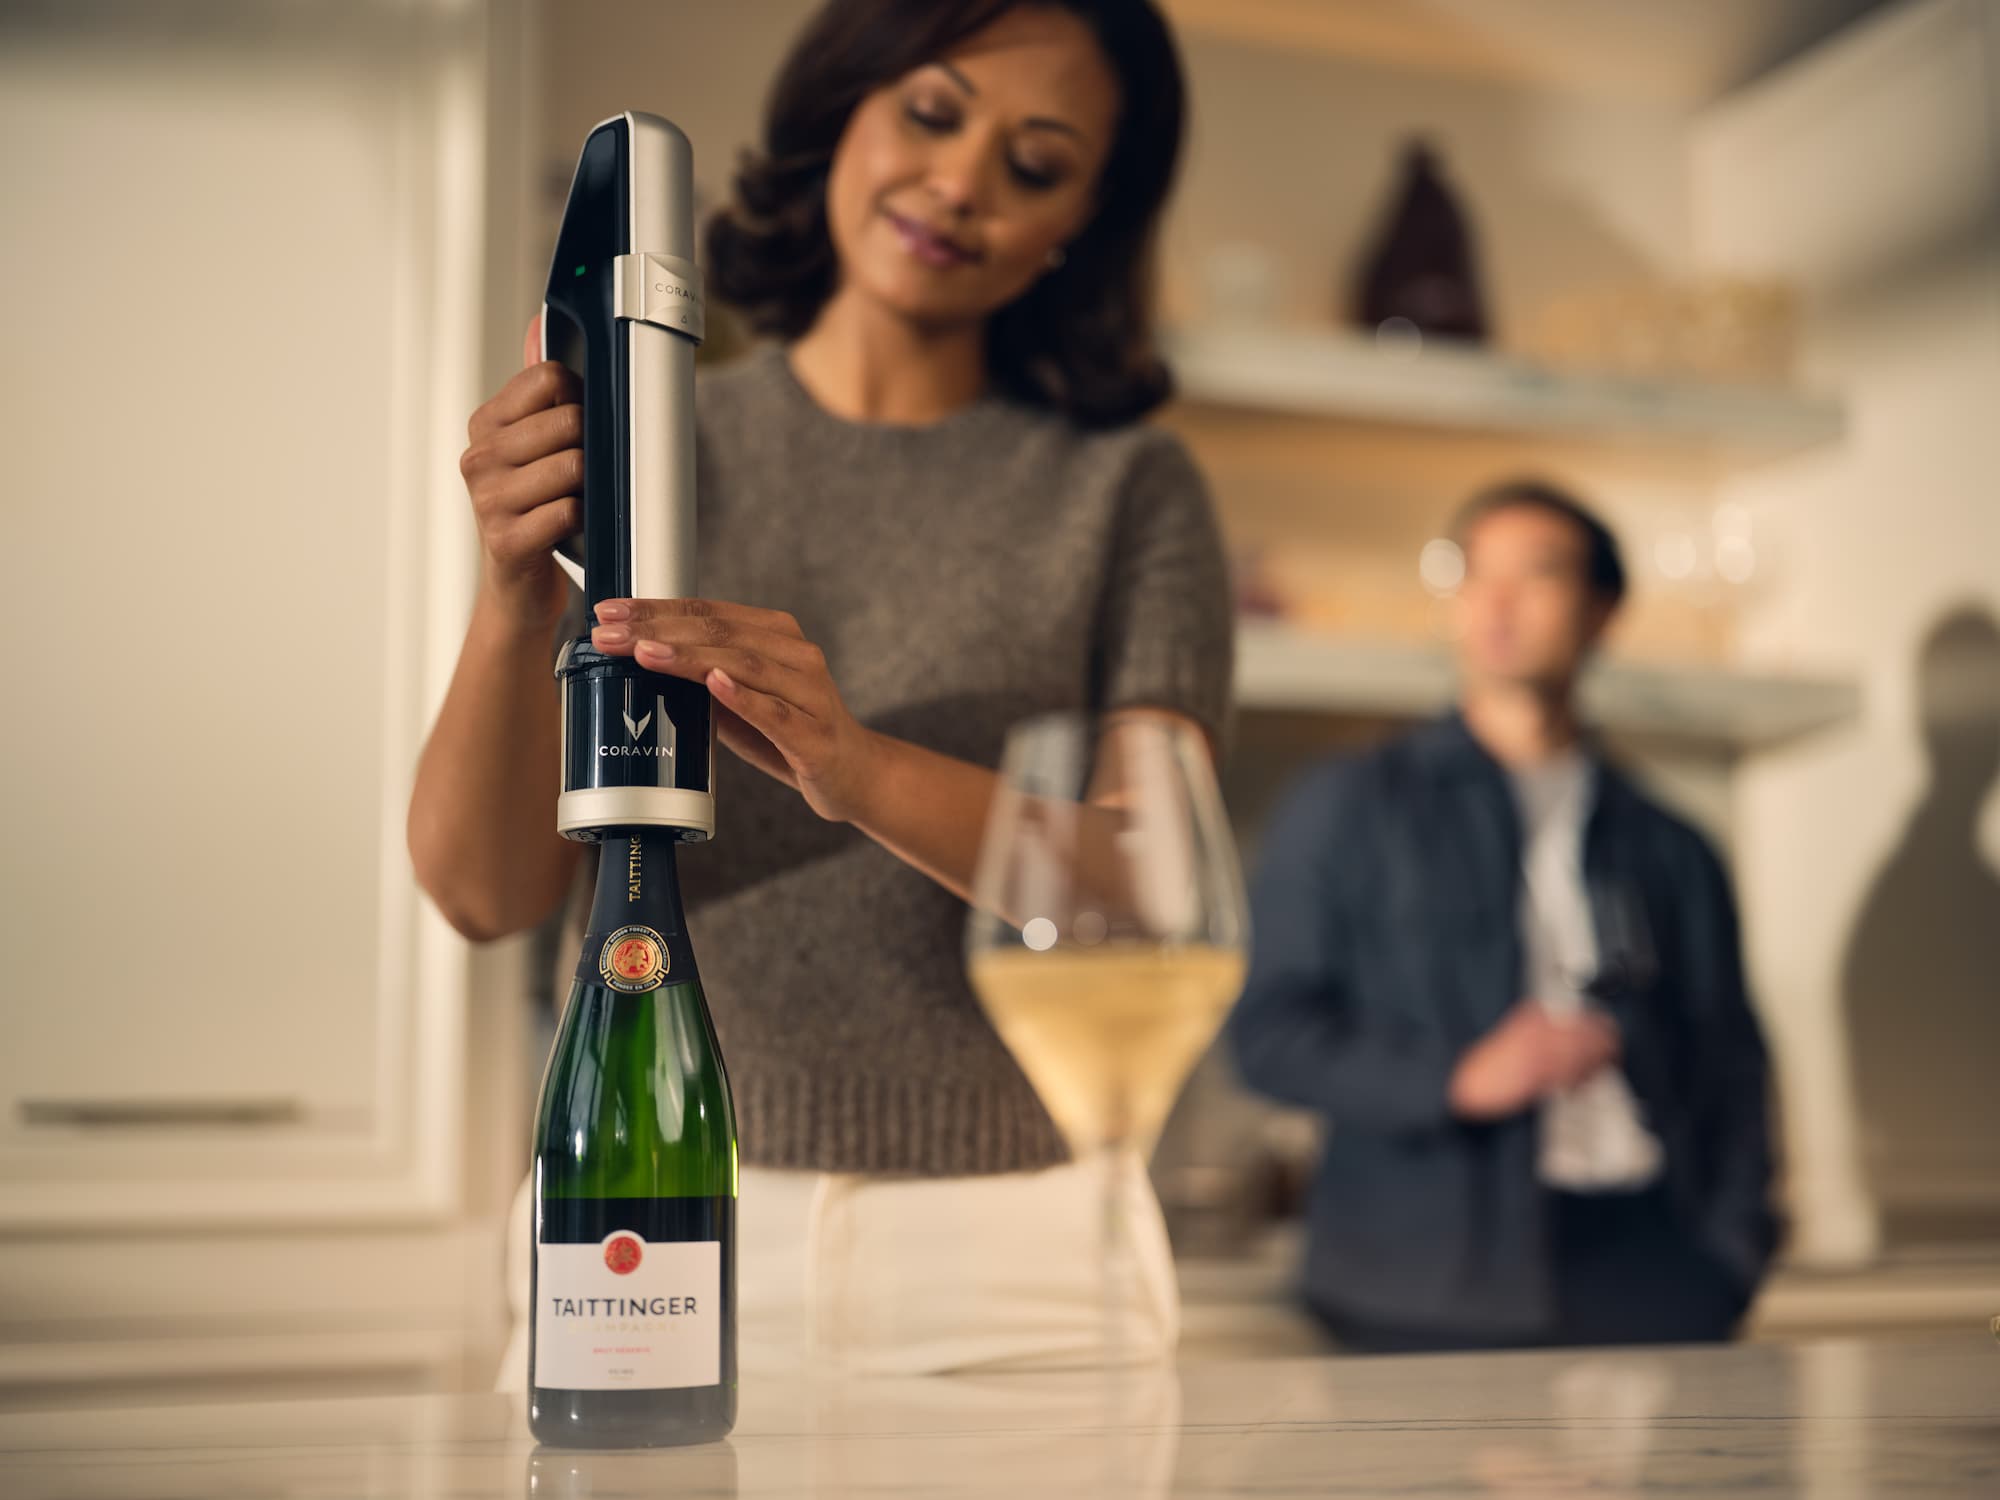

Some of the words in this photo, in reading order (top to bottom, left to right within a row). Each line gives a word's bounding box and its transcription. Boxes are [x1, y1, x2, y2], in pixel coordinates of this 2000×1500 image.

[655, 283, 698, 302] CORAV
[599, 745, 673, 757] CORAVIN
[552, 1297, 697, 1317] TAITTINGER
